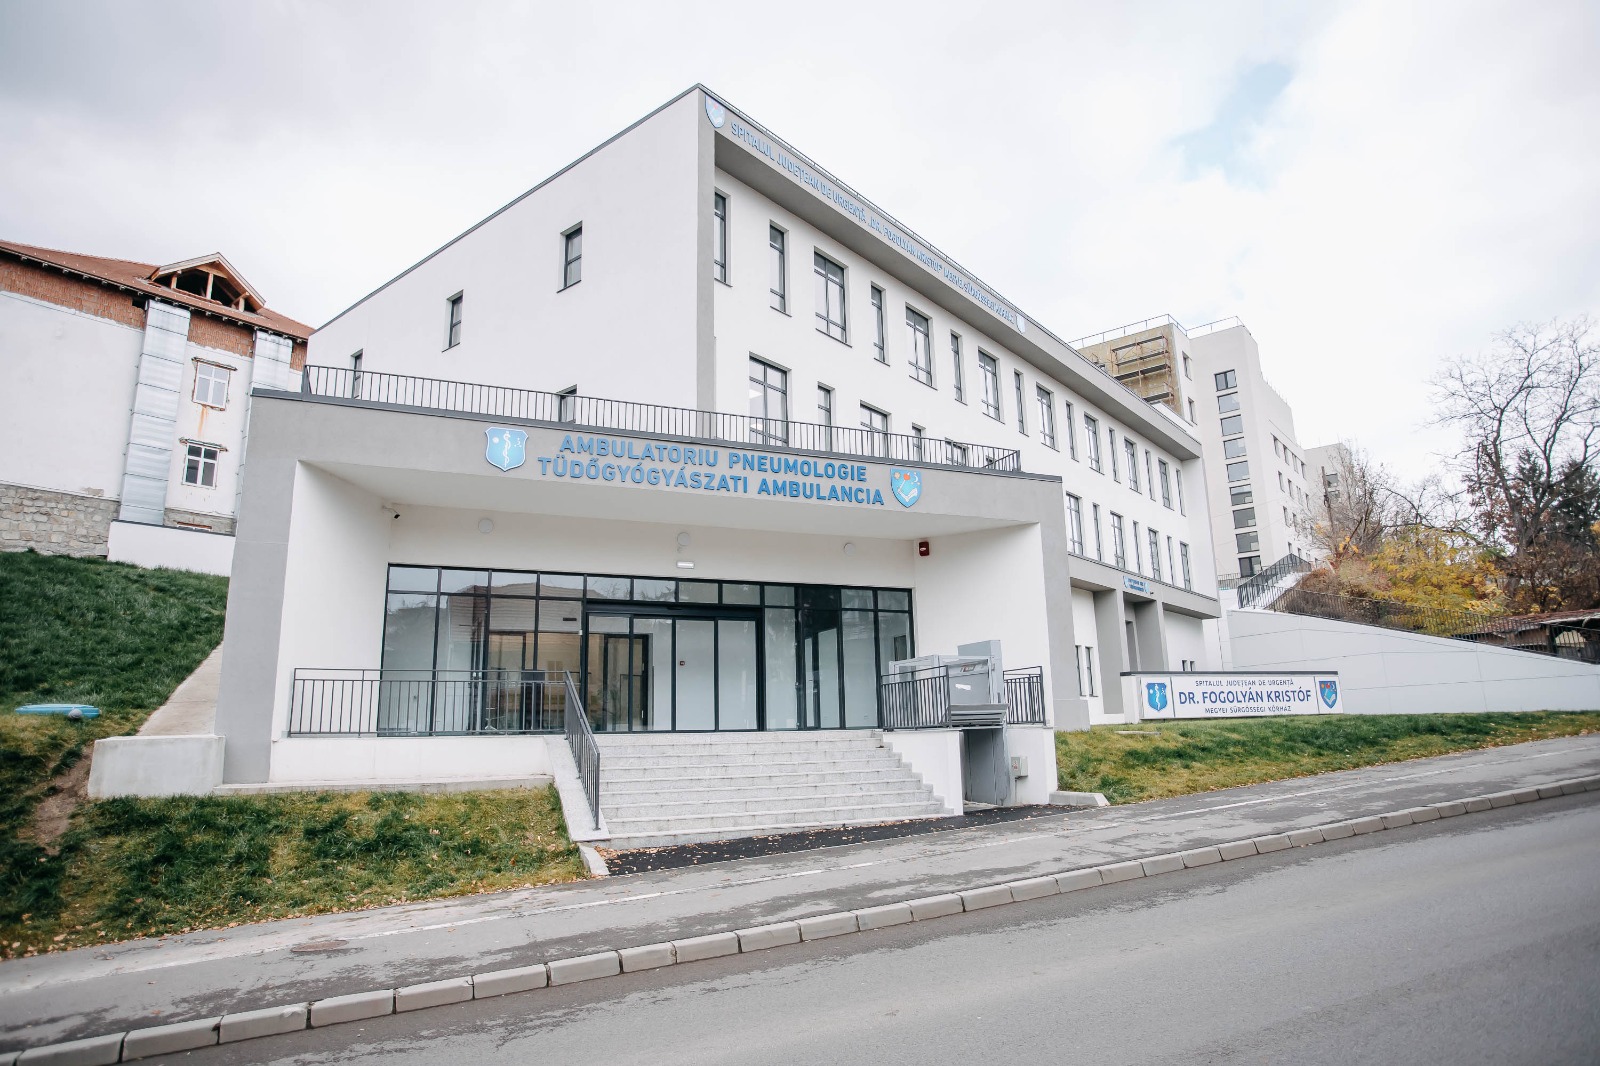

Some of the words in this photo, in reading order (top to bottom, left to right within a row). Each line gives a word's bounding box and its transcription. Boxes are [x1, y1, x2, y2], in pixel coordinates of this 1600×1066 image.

[731, 122, 775, 161] SPITALUL
[820, 182, 832, 200] DE
[538, 454, 748, 493] TÜDŐGYÓGYÁSZATI
[757, 478, 885, 505] AMBULANCIA
[559, 434, 719, 467] AMBULATORIU
[728, 452, 867, 482] PNEUMOLOGIE
[1179, 691, 1200, 705] DR.
[1202, 687, 1263, 704] FOGOLYÁN
[1266, 686, 1312, 703] KRISTÓF
